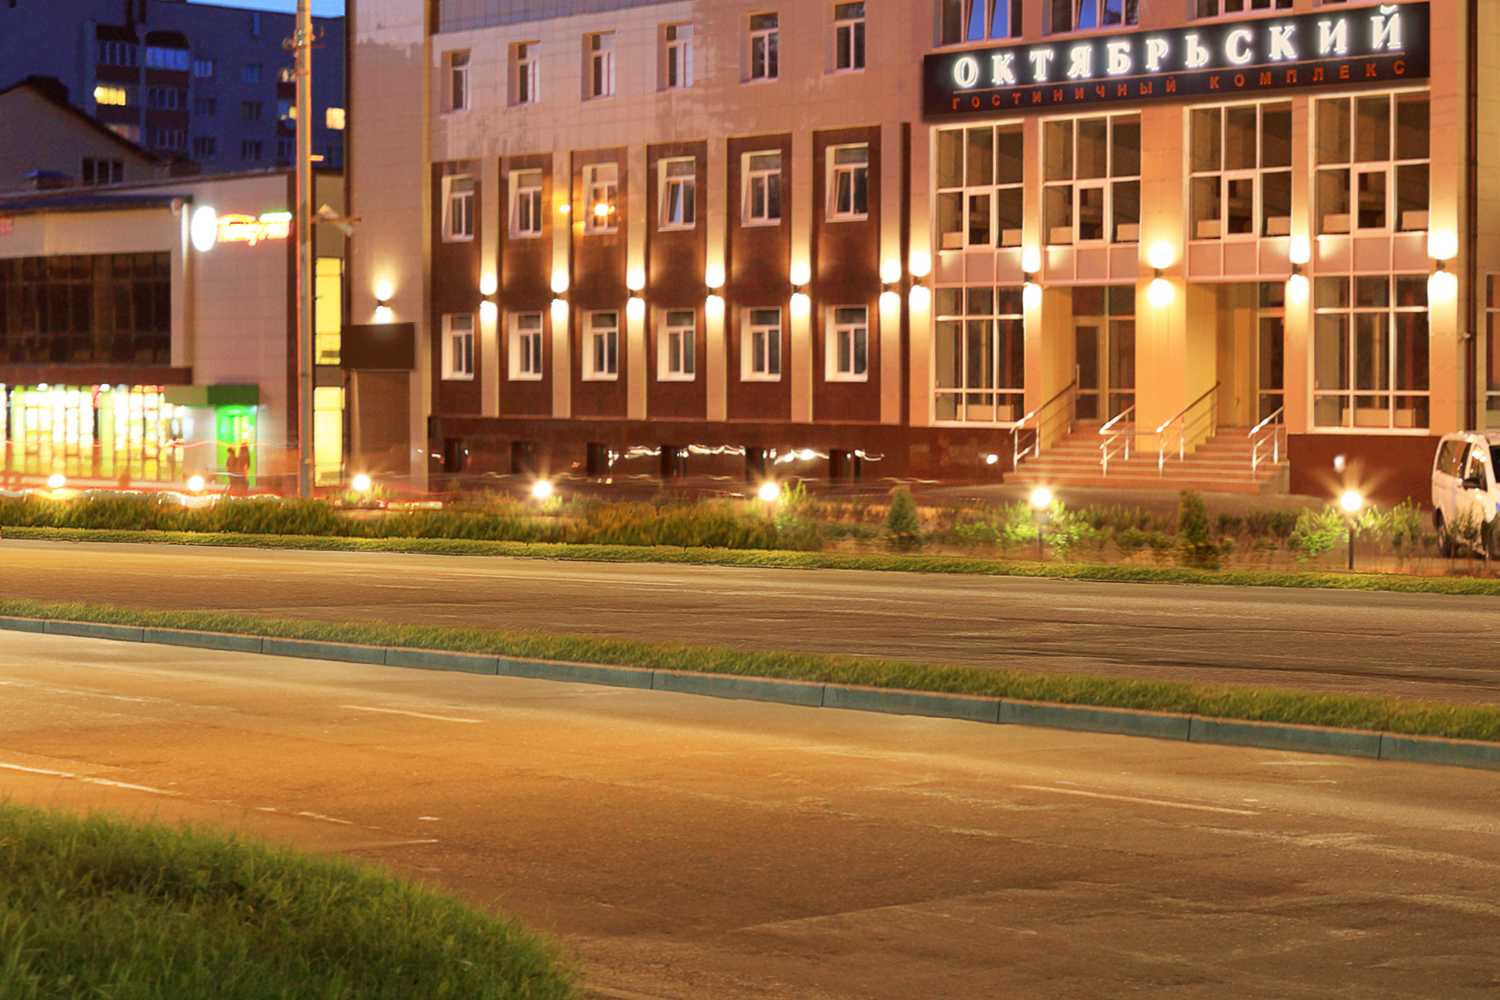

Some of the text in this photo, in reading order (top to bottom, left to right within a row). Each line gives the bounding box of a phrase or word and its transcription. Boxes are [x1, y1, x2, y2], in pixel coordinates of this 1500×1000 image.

[953, 4, 1402, 88] ОКТЯБРЬСКИЙ
[952, 60, 1406, 110] ГОСТИНИЧНЫЙ КОМПЛЕКС
